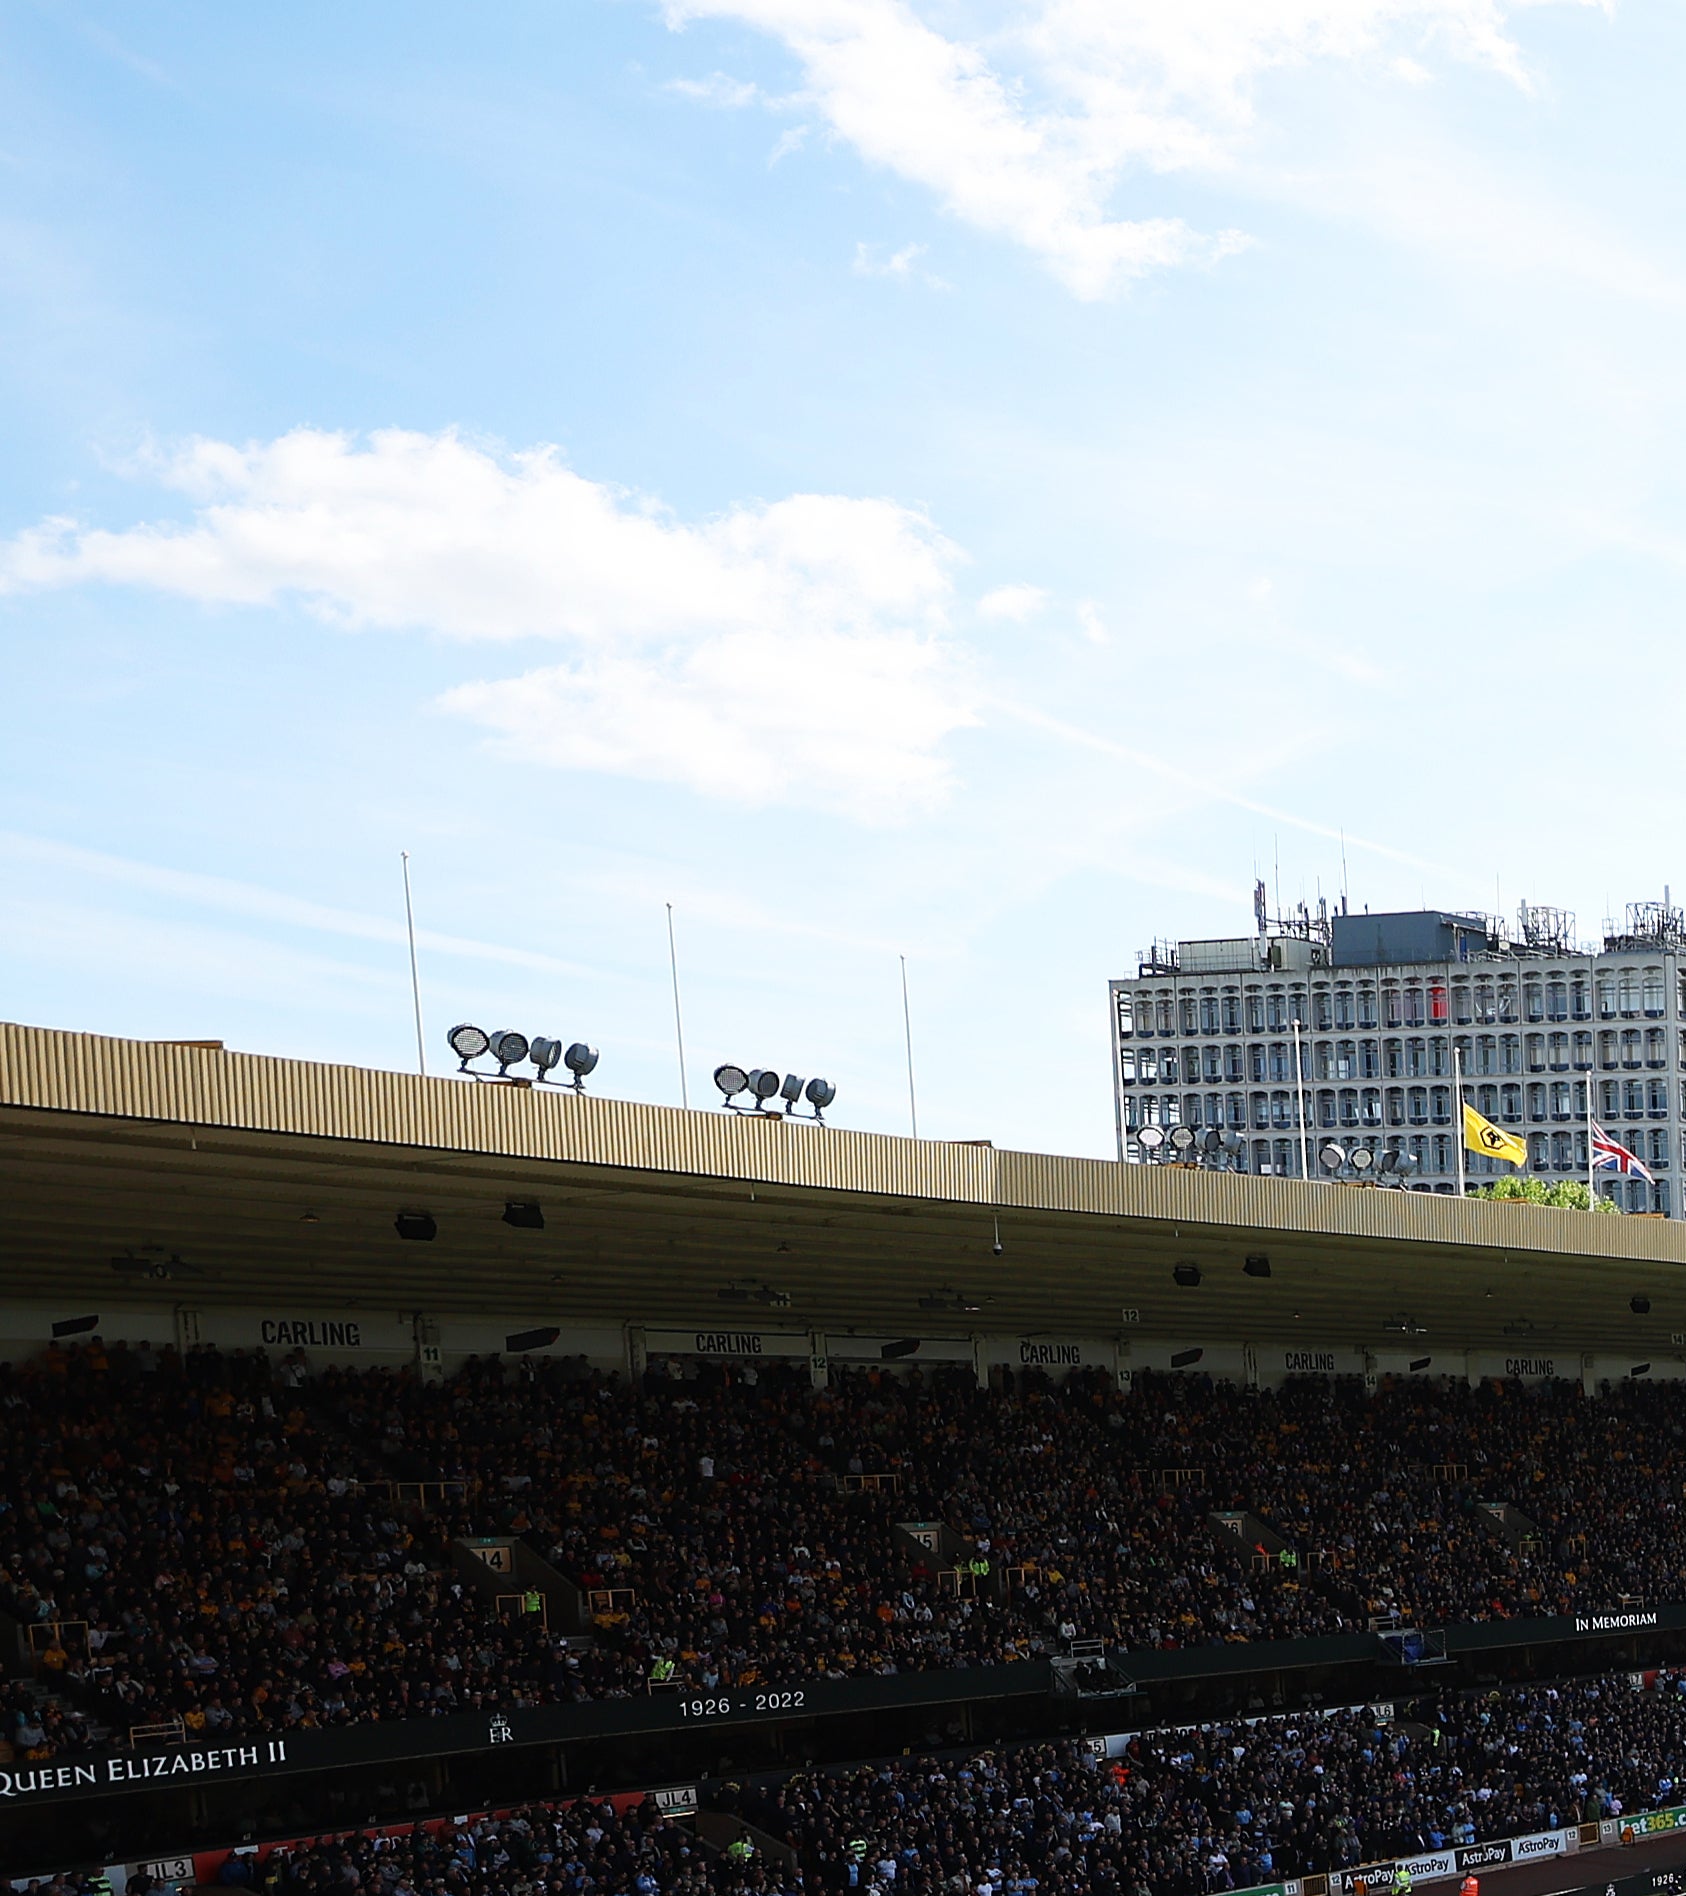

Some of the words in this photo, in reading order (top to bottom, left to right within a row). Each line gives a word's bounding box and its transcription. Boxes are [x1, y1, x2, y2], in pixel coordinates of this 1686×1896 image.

[1123, 1309, 1138, 1321] 12
[261, 1320, 361, 1346] CARLING
[696, 1333, 762, 1354] CARLING
[424, 1347, 439, 1361] 11
[811, 1356, 826, 1369] 12
[1020, 1344, 1080, 1365] CARLING
[1285, 1351, 1335, 1372] CARLING
[1118, 1369, 1131, 1382] 13
[1505, 1358, 1553, 1376] CARLING
[1575, 1617, 1590, 1632] IN
[1593, 1611, 1657, 1631] MEMORIAM
[679, 1697, 730, 1718] 1926
[755, 1690, 806, 1713] 2022
[0, 1763, 97, 1798] QUEEN
[107, 1745, 259, 1782] ELIZABETH
[267, 1740, 287, 1764] II
[660, 1788, 691, 1808] JL4
[1518, 1836, 1560, 1855] AstroPay
[1652, 1873, 1675, 1887] 1926
